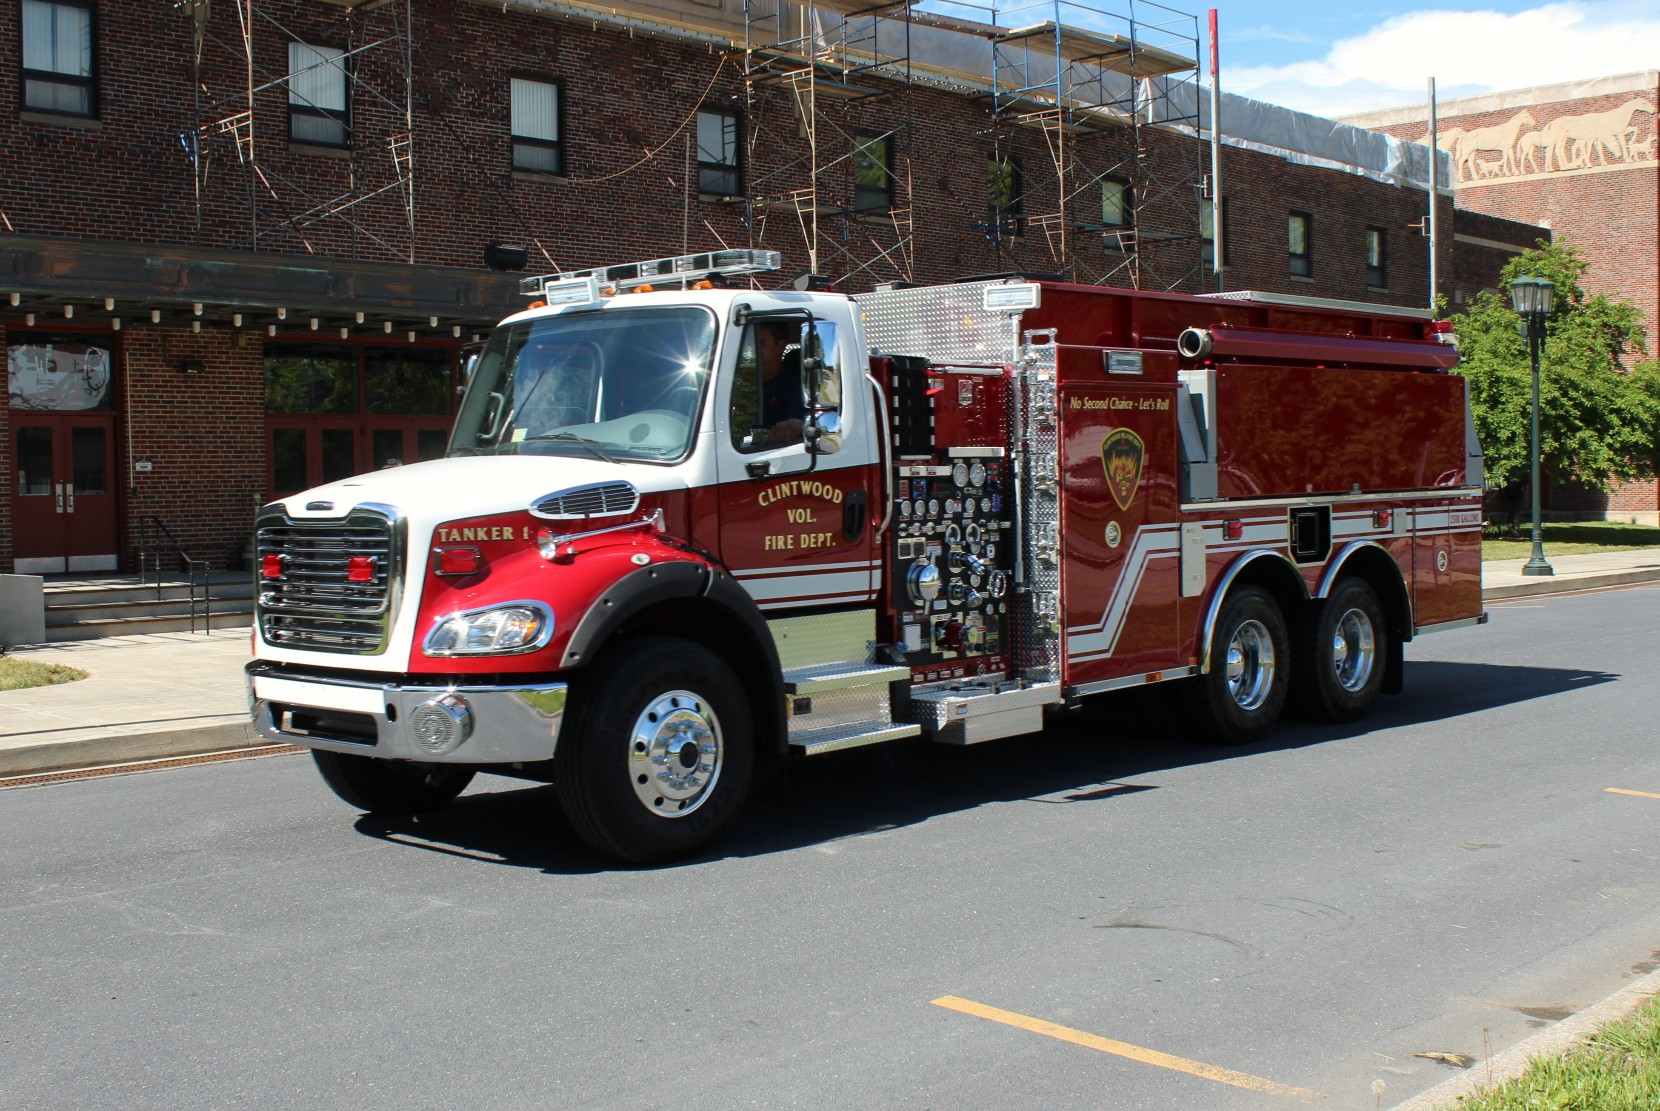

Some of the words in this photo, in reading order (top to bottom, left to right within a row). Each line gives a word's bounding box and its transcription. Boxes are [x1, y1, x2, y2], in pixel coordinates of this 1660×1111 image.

[1070, 396, 1081, 409] No
[1083, 397, 1109, 409] Second
[1110, 397, 1133, 410] Chance
[1139, 398, 1155, 410] Let's
[1156, 398, 1170, 411] Roll
[758, 481, 843, 506] CLINTWOOD
[787, 509, 816, 523] VOL.
[438, 527, 514, 542] TANKER
[522, 526, 530, 540] 1
[765, 535, 794, 550] FIRE
[800, 533, 836, 548] DEPT.
